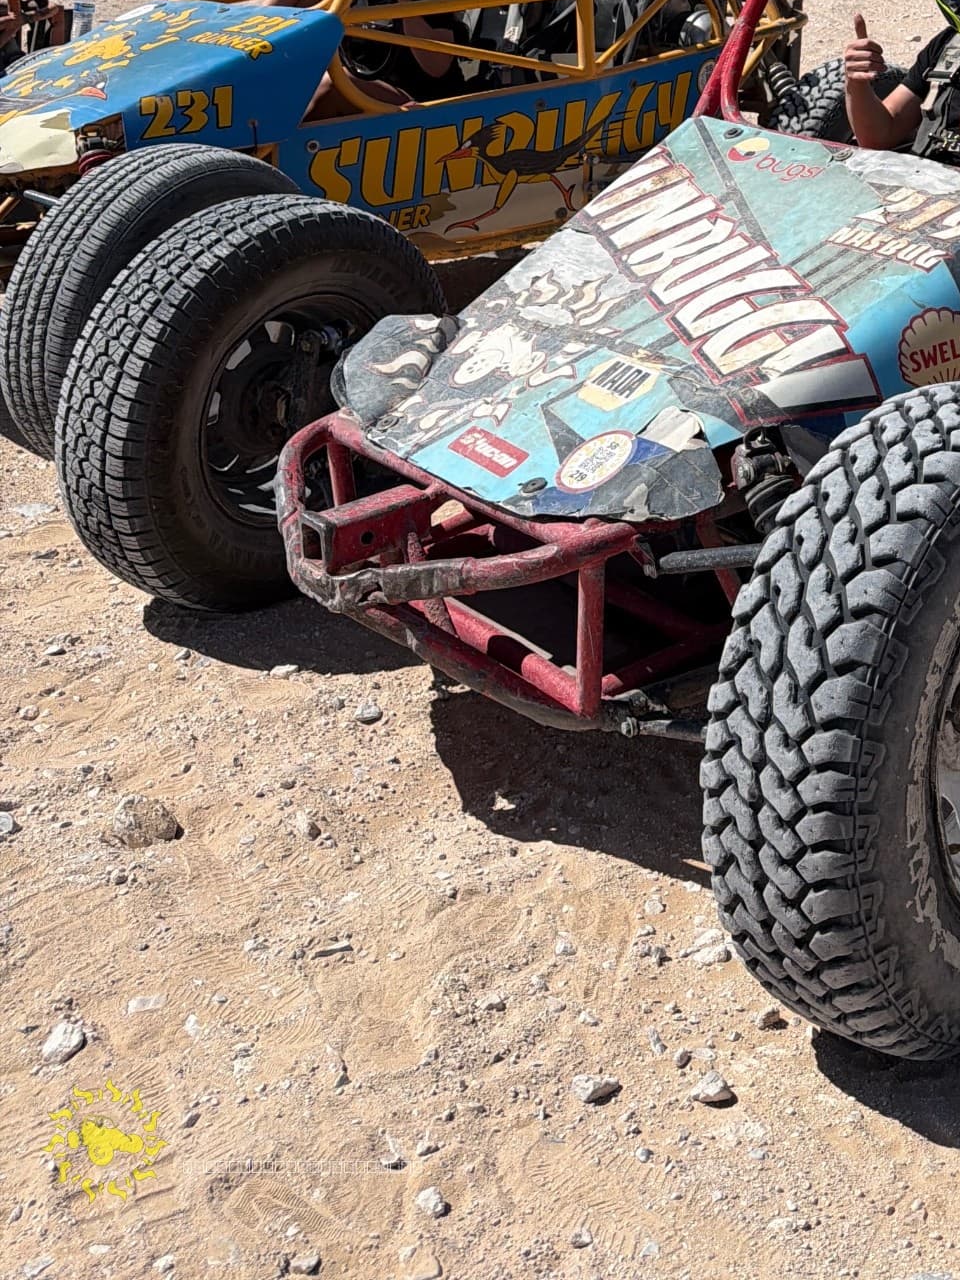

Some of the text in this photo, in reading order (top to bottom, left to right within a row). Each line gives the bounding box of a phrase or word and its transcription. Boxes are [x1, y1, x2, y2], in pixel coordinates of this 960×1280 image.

[186, 31, 273, 61] RUNNER
[139, 85, 234, 140] 231
[824, 225, 953, 273] NASBUG
[591, 360, 651, 399] NADA
